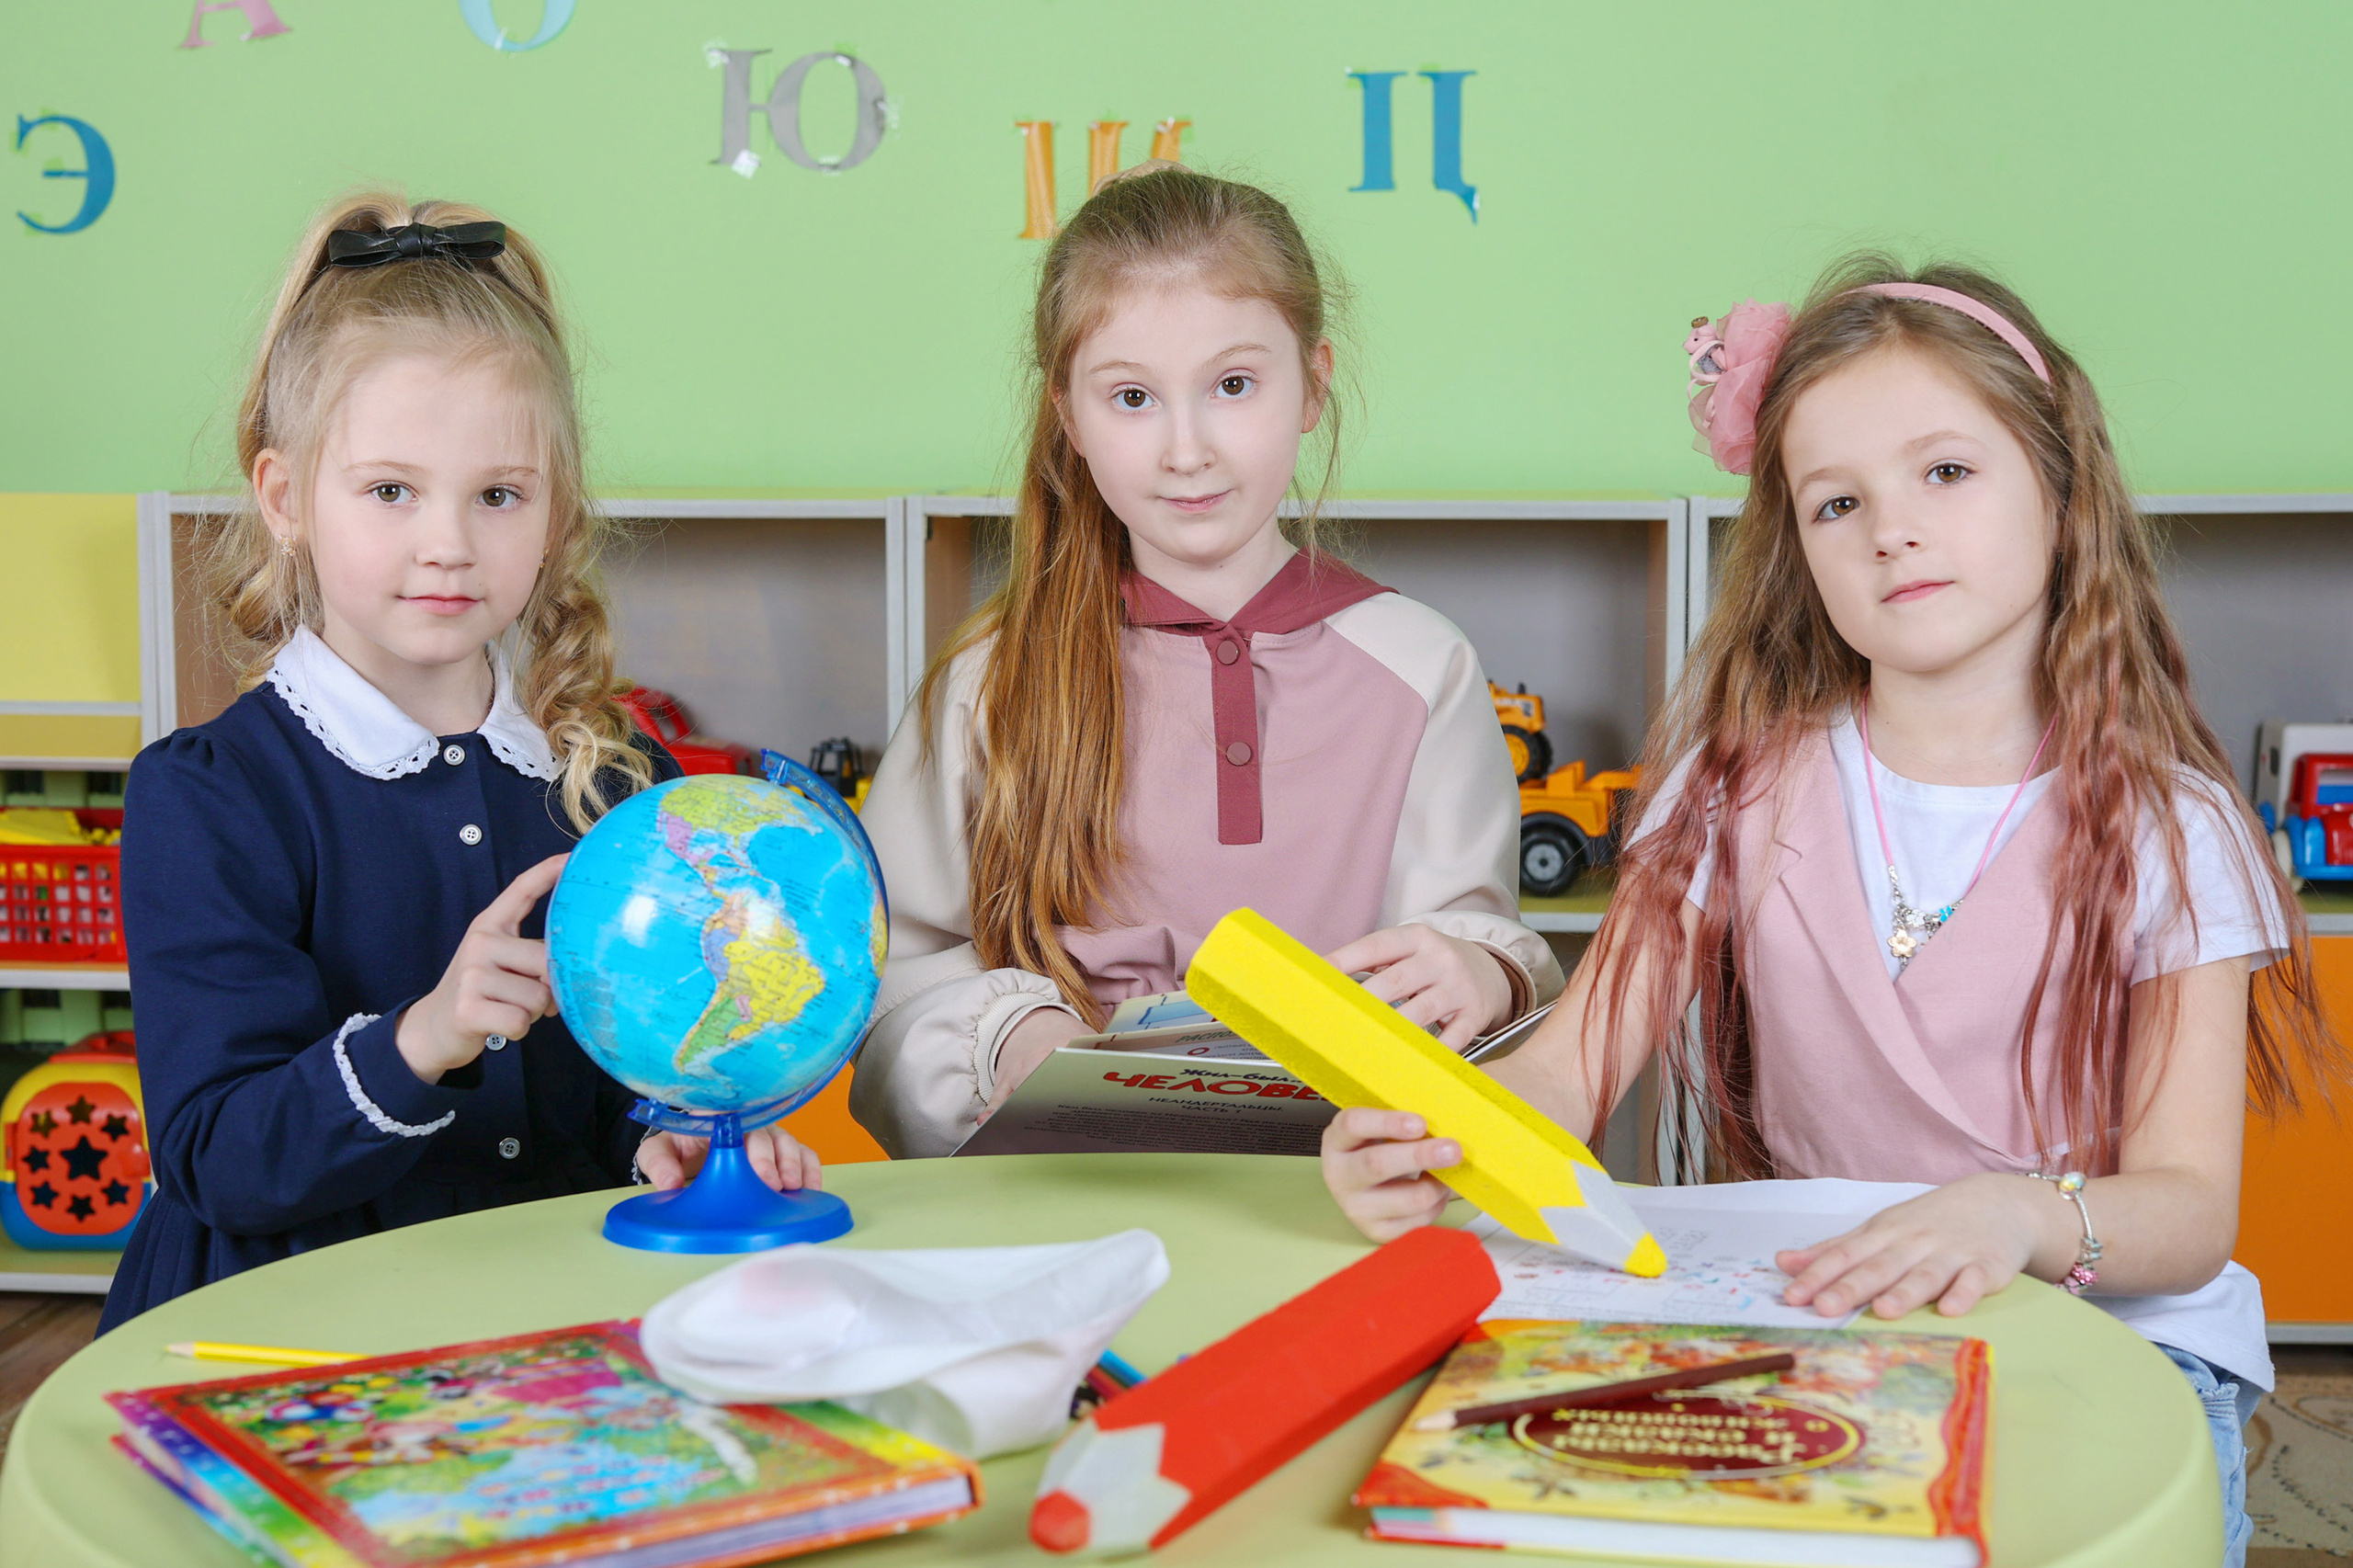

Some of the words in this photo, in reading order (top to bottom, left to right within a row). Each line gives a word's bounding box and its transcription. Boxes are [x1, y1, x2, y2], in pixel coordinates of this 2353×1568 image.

[710, 48, 886, 172] Ю
[1347, 69, 1479, 223] Ц
[16, 112, 116, 234] Э
[1103, 1072, 1329, 1101] ЧЕЛОВЕ
[1148, 1096, 1284, 1112] НЕАНДЕРТАЛЬЦЫ.
[1181, 1105, 1229, 1113] ЧАСТЬ
